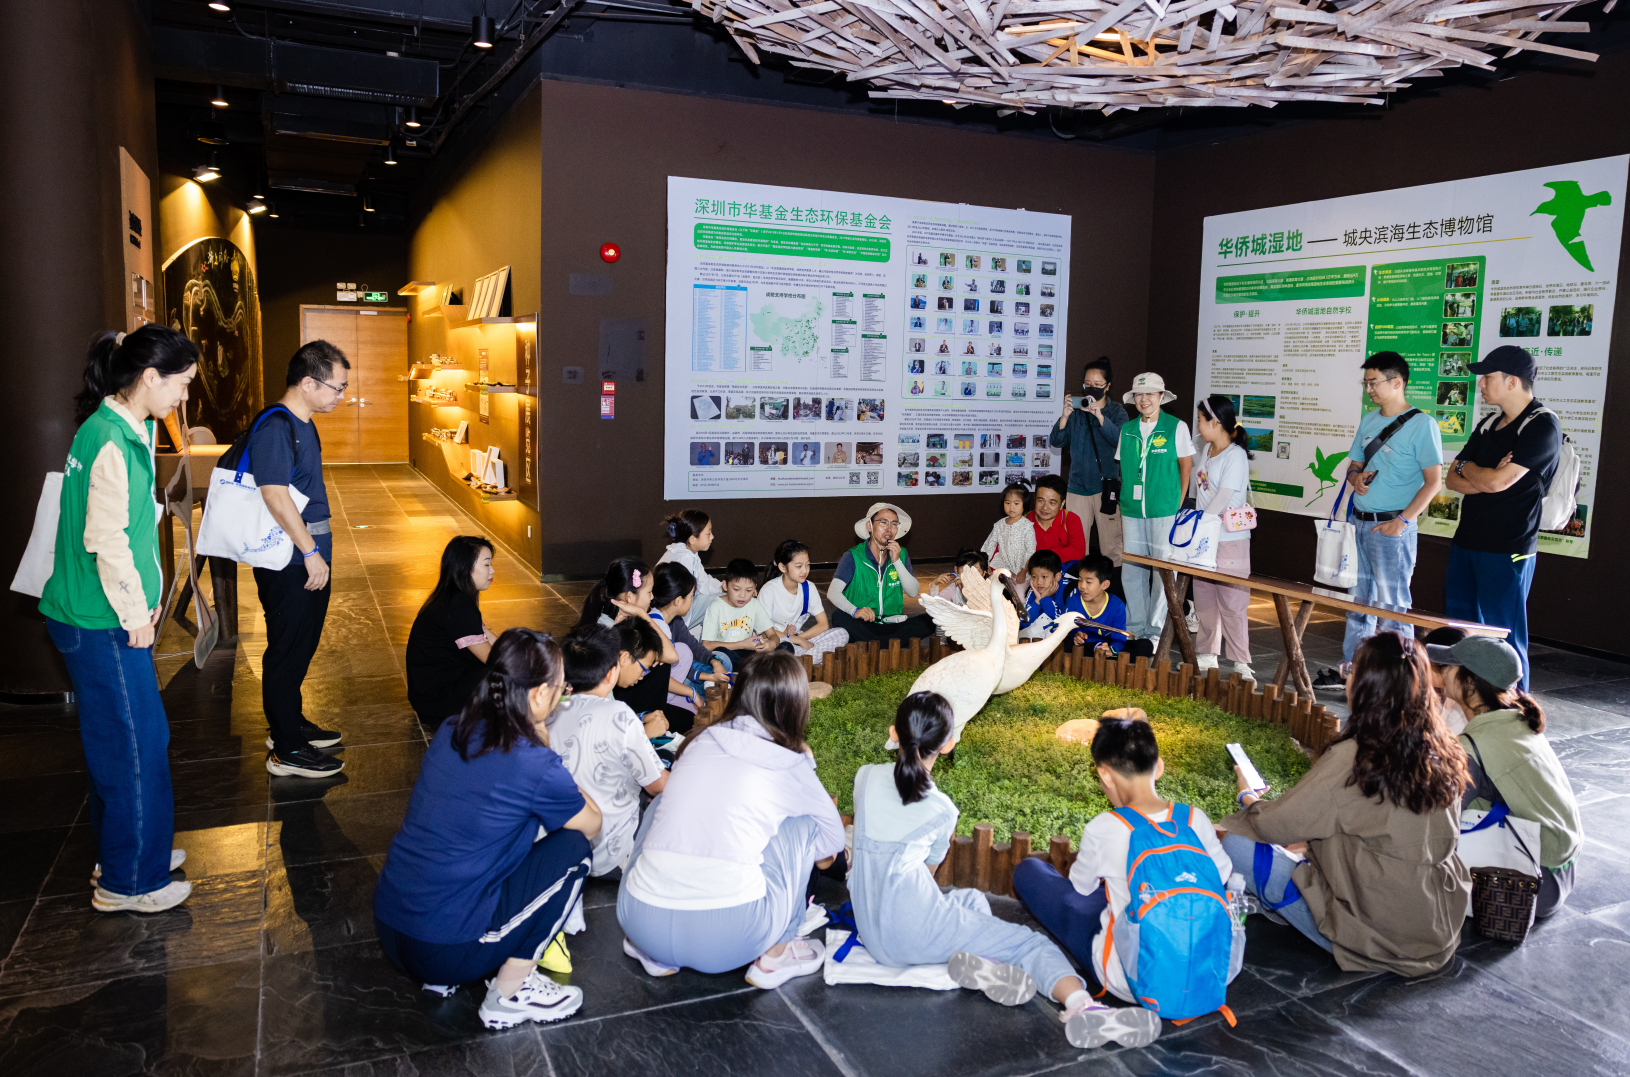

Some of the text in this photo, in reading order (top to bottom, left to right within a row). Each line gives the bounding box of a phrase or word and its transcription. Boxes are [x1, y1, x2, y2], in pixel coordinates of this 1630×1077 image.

[694, 198, 892, 230] 深圳市华基金生态环保基金会
[1218, 229, 1303, 259] 华侨城湿地
[1343, 214, 1494, 247] 城央滨海生态博物馆
[1296, 306, 1352, 316] 华侨城湿地自然学校
